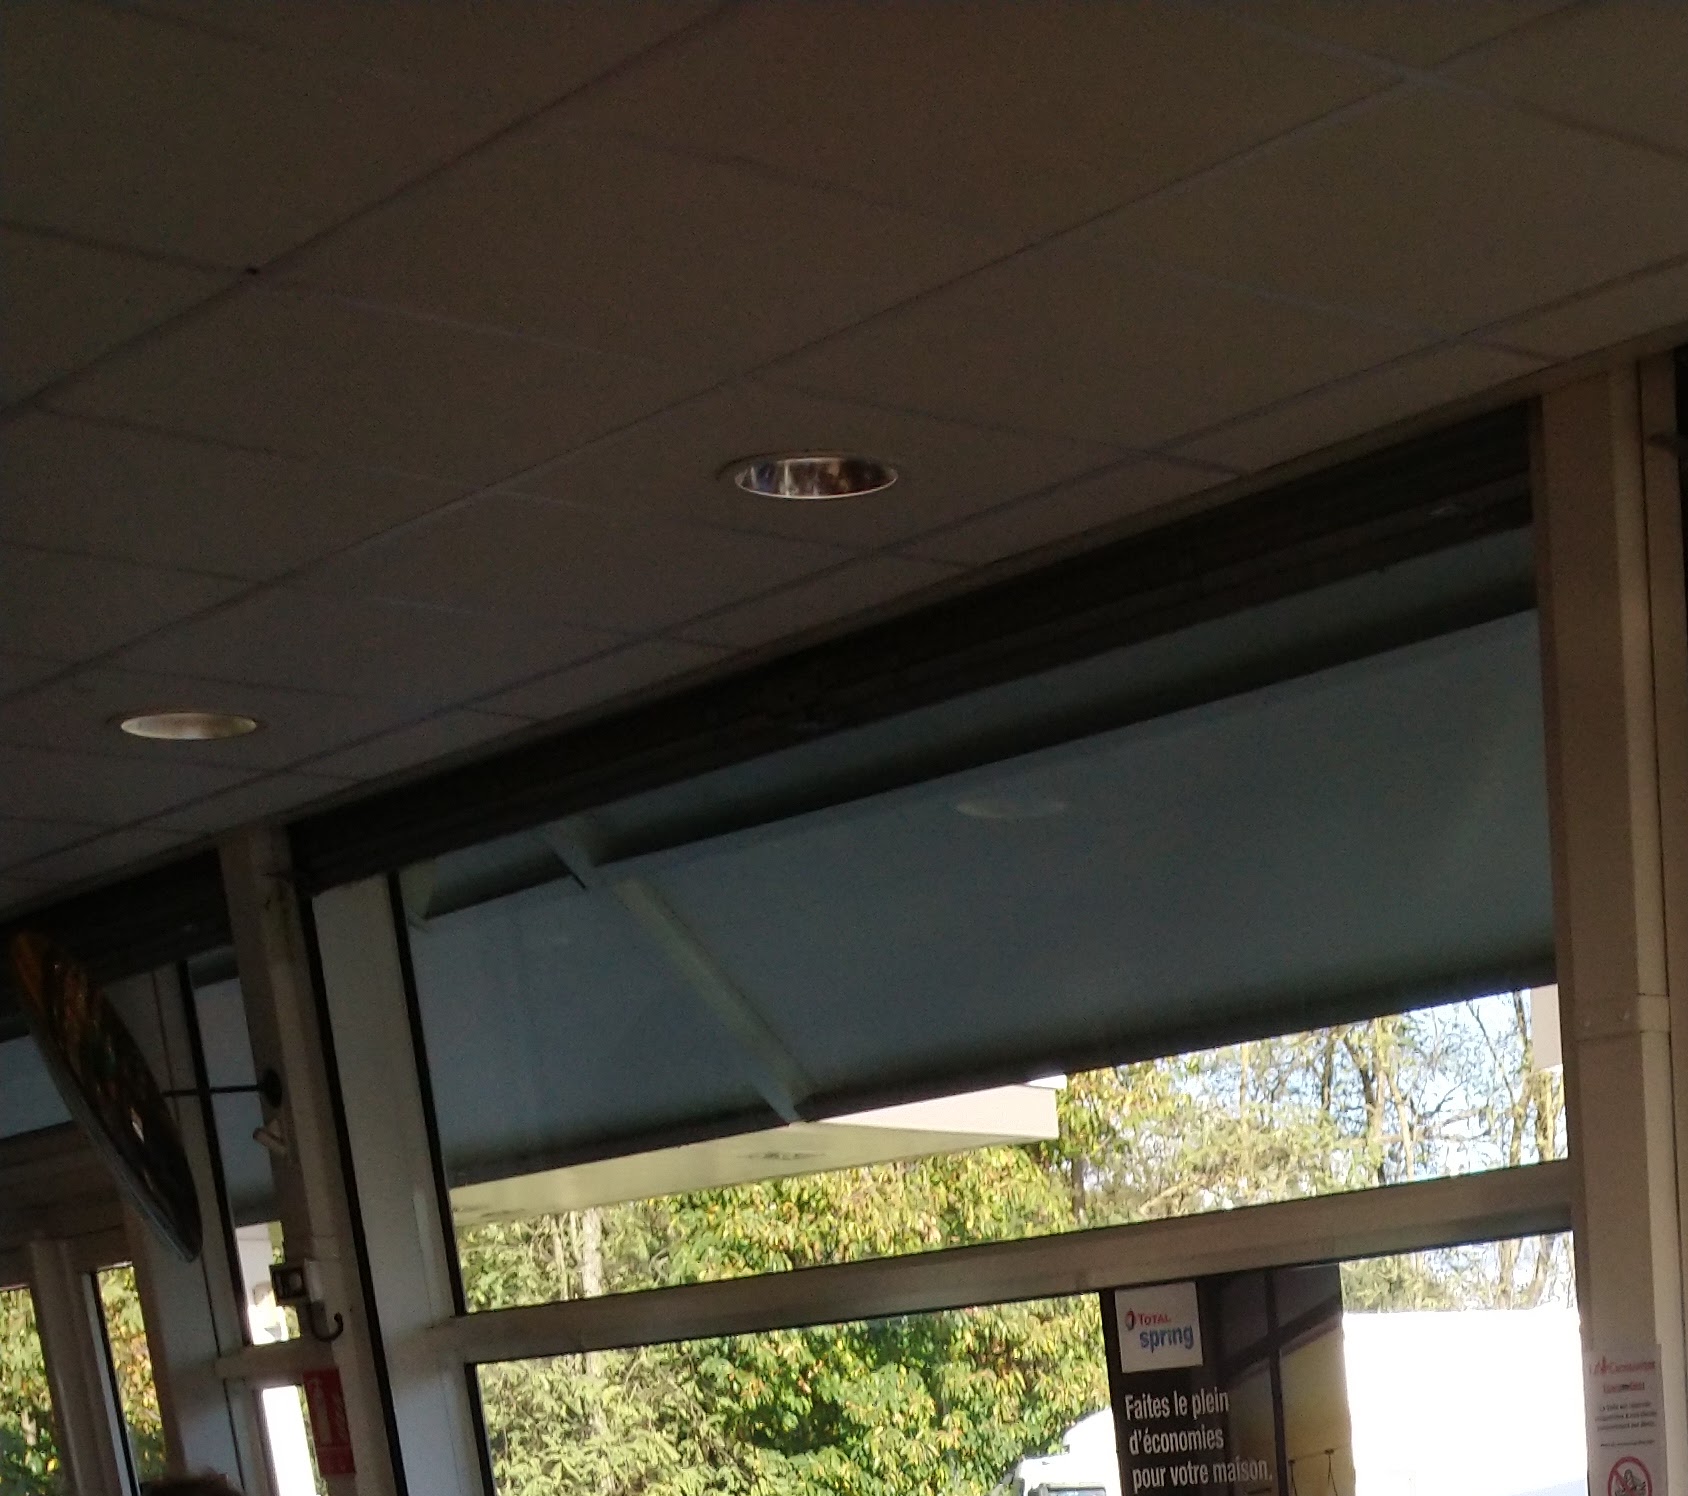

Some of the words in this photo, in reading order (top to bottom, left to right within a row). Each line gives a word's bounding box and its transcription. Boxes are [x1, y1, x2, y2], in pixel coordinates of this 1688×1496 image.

[1137, 1313, 1170, 1325] TOTAL
[1139, 1325, 1195, 1352] spring
[1125, 1391, 1170, 1421] Faites
[1174, 1390, 1187, 1417] le
[1192, 1386, 1230, 1420] plein
[1129, 1423, 1225, 1455] d'économies
[1132, 1466, 1167, 1494] pour
[1170, 1461, 1208, 1485] votre
[1213, 1456, 1273, 1484] maison.
